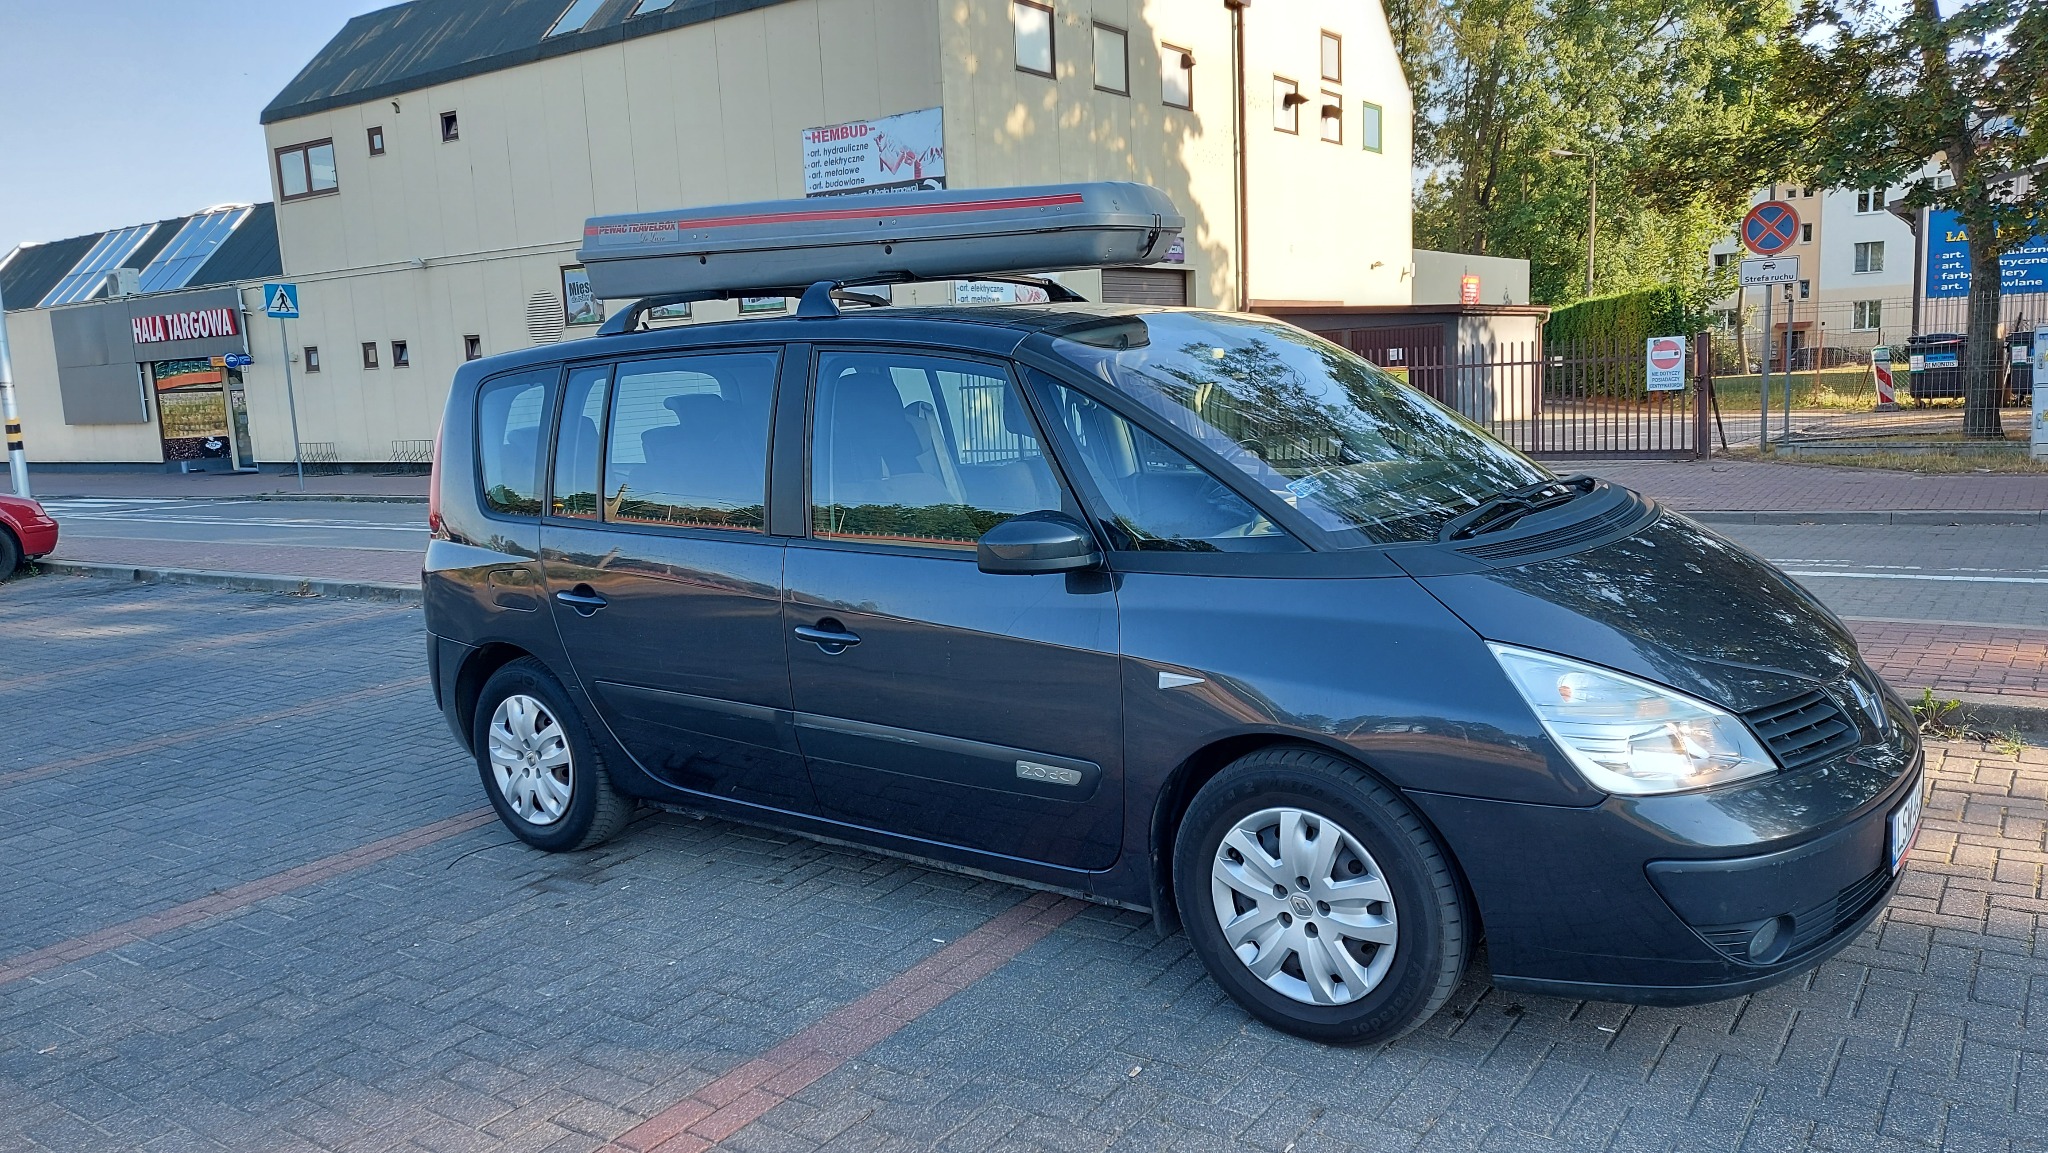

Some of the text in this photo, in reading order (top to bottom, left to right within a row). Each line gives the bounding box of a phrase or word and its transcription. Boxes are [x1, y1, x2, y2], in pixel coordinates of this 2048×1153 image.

[810, 142, 869, 158] art. hydrauliczne
[811, 154, 865, 169] art. elektryczne
[811, 166, 860, 179] art. metalowe
[813, 176, 865, 190] art. budowlane
[628, 220, 676, 233] TRAVELBOX
[1941, 251, 1965, 259] art.
[1941, 262, 1964, 270] art.
[1744, 273, 1794, 283] Strefa ruchu
[971, 283, 1004, 293] elektryczne
[1940, 282, 1964, 291] art.
[131, 308, 233, 344] HALA TARGOWA
[1019, 765, 1047, 778] 2.0
